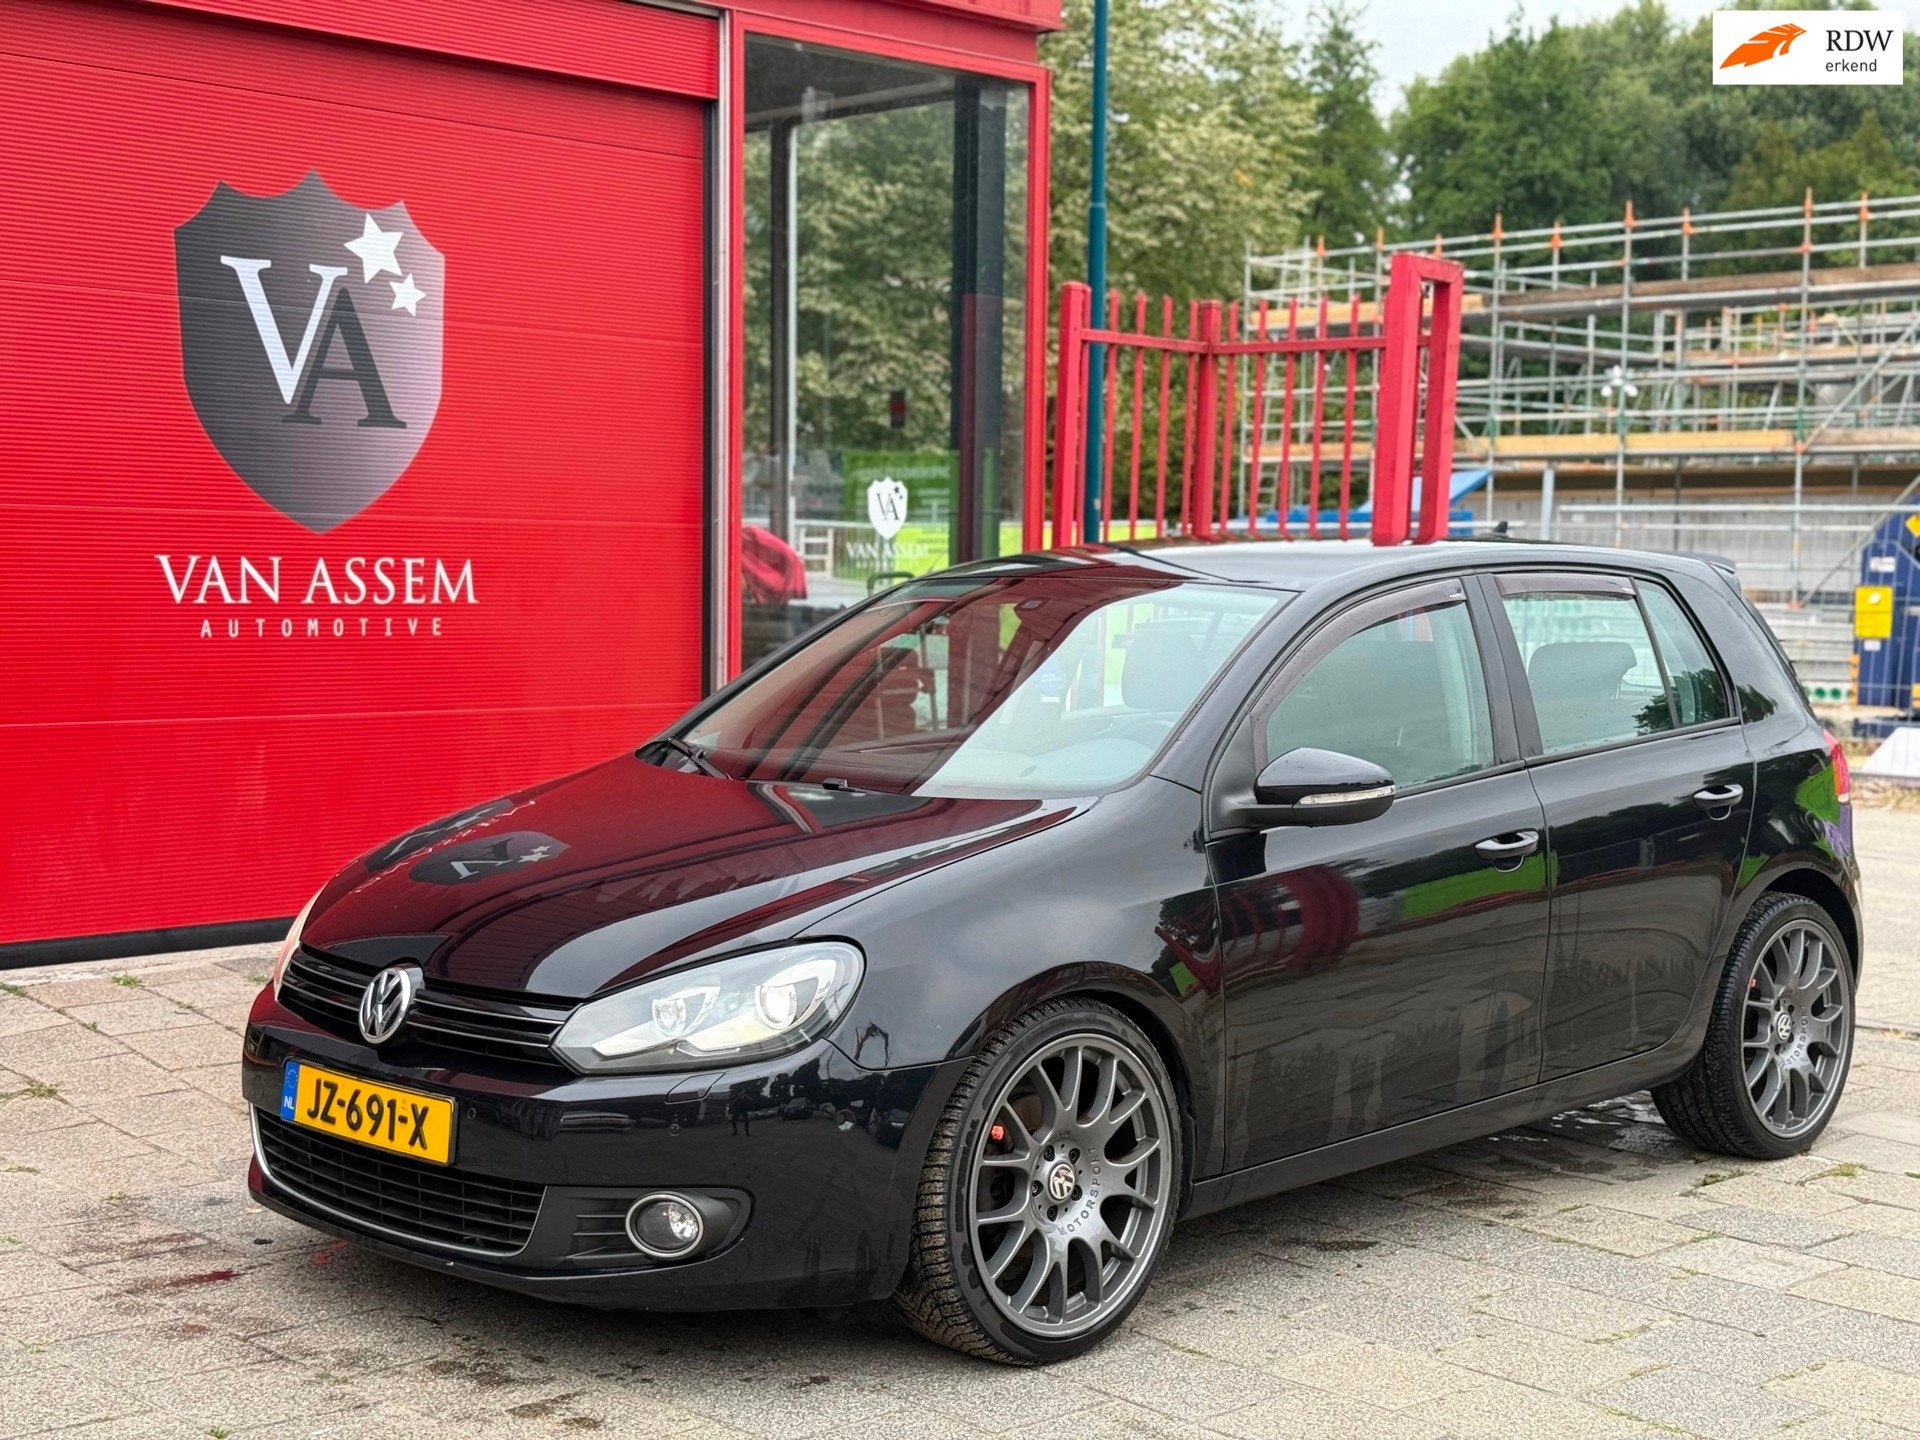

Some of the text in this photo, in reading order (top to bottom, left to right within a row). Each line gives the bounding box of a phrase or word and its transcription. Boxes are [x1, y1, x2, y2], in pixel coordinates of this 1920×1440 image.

[220, 254, 408, 429] VA
[155, 554, 479, 604] VAN ASSEM
[200, 617, 443, 638] AUTOMOTIVE
[283, 1095, 295, 1110] NL
[306, 1078, 429, 1150] JZ-691-X
[1057, 1147, 1101, 1235] MOTORSPORT
